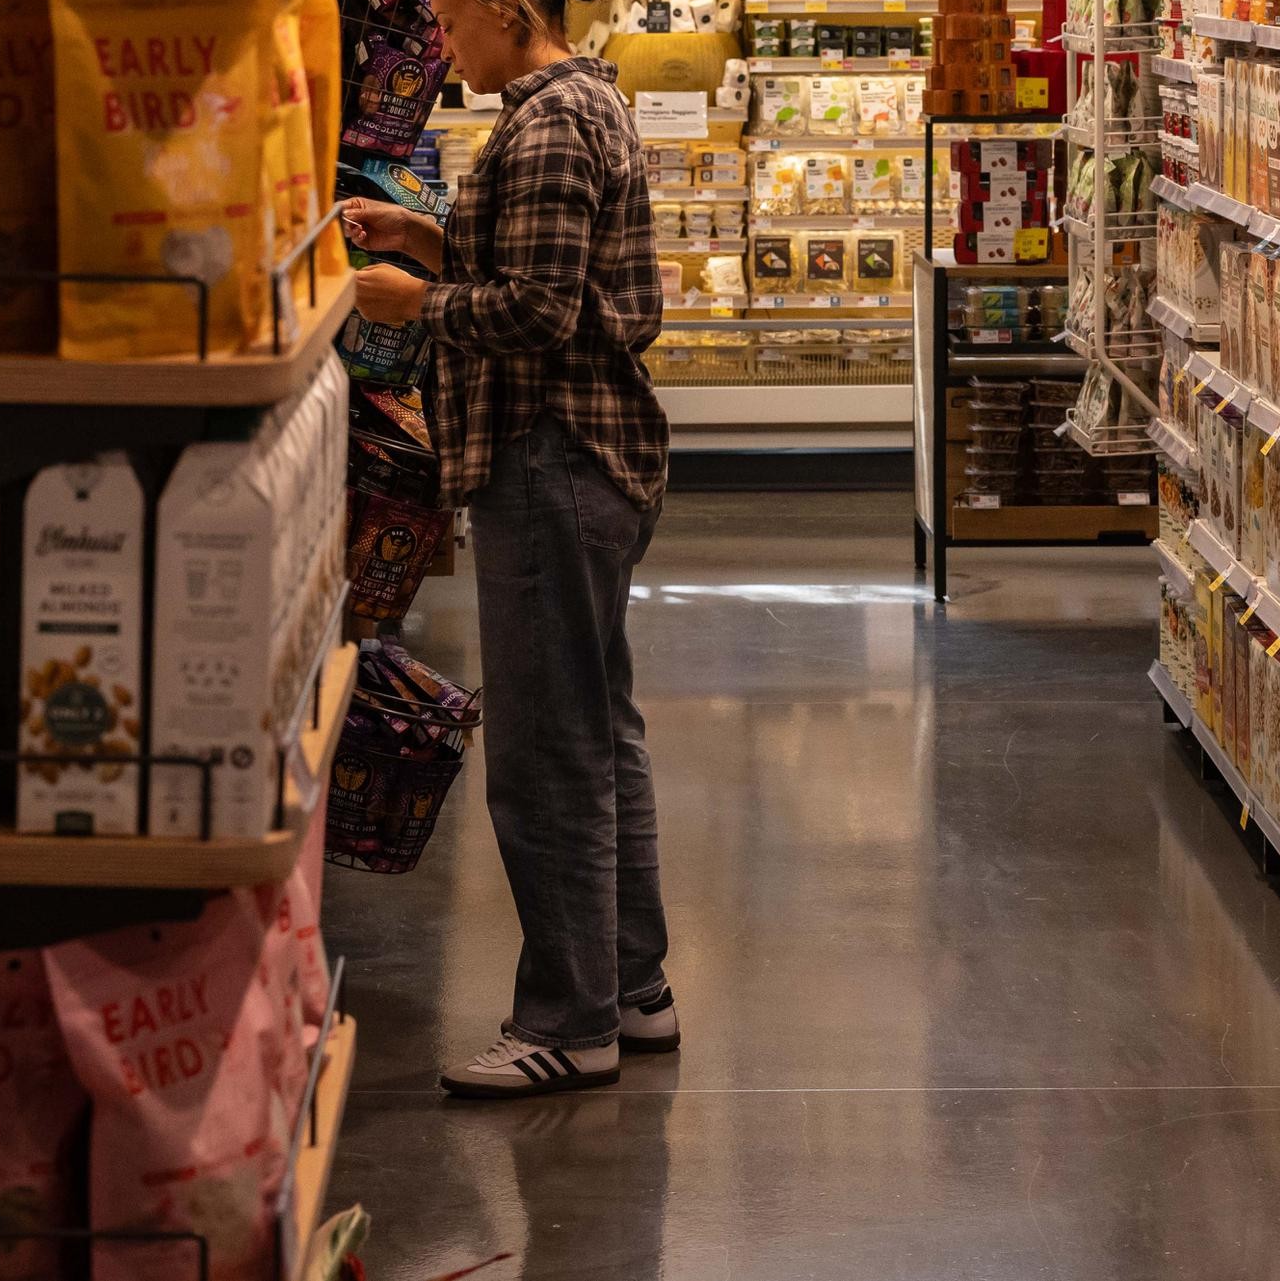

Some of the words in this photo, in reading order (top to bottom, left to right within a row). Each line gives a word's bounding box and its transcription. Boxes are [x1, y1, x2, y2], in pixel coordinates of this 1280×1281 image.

[96, 36, 218, 77] EARLY
[104, 92, 196, 132] BIRD
[101, 974, 209, 1043] EARLY
